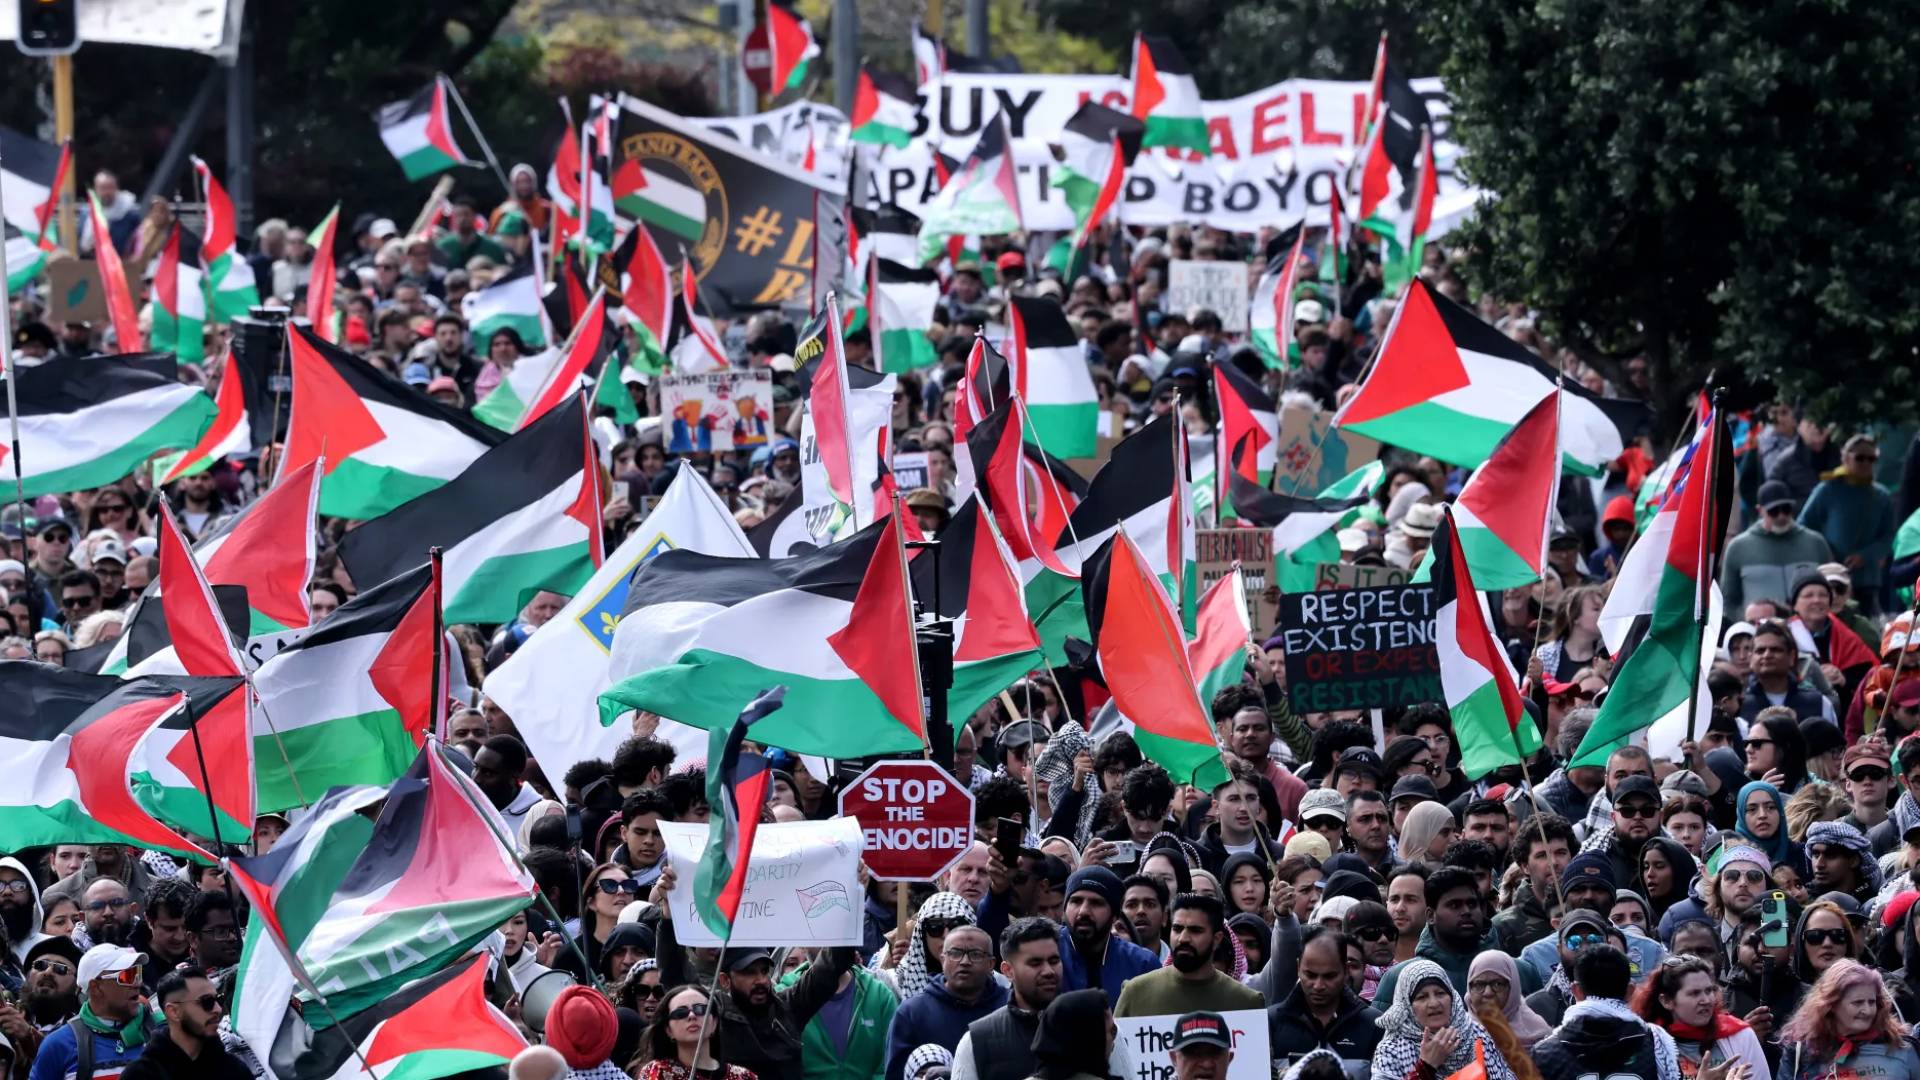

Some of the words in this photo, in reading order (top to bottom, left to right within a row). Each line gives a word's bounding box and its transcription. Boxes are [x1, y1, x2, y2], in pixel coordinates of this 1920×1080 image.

[910, 86, 1044, 138] BUY
[1319, 563, 1340, 585] IS
[1355, 568, 1377, 588] IT
[1301, 588, 1434, 624] RESPECT
[1284, 619, 1437, 655] EXISTENC
[1306, 653, 1343, 681] OR
[1353, 648, 1438, 674] EXPEC
[1293, 674, 1440, 712] RESISTAN
[863, 777, 947, 804] STOP
[885, 806, 925, 822] THE
[862, 827, 967, 851] ENOCIDE
[748, 862, 804, 886] DARITY
[1135, 1025, 1175, 1053] the
